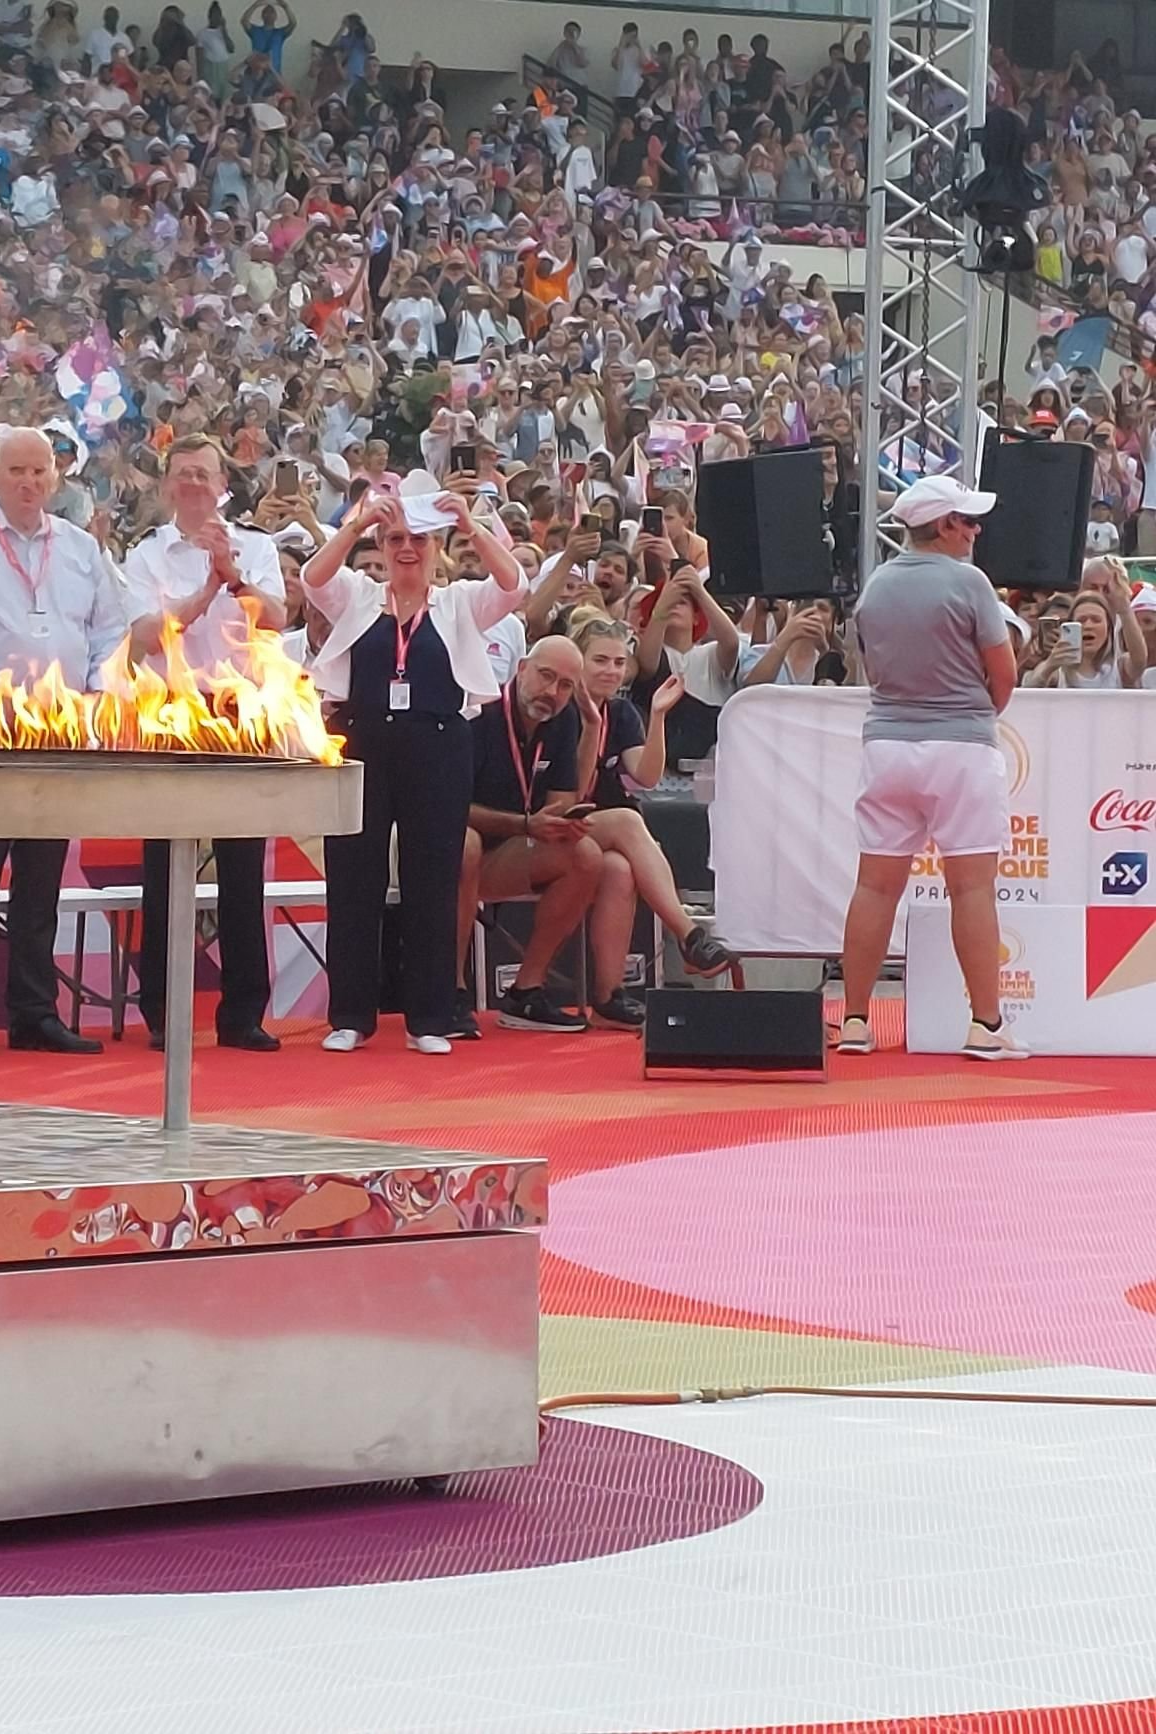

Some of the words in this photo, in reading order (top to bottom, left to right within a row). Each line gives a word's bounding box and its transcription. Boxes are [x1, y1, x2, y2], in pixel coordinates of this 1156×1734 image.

[1089, 788, 1156, 832] Coca
[1010, 815, 1039, 835] DE
[1010, 838, 1049, 856] ME
[997, 888, 1039, 902] 024
